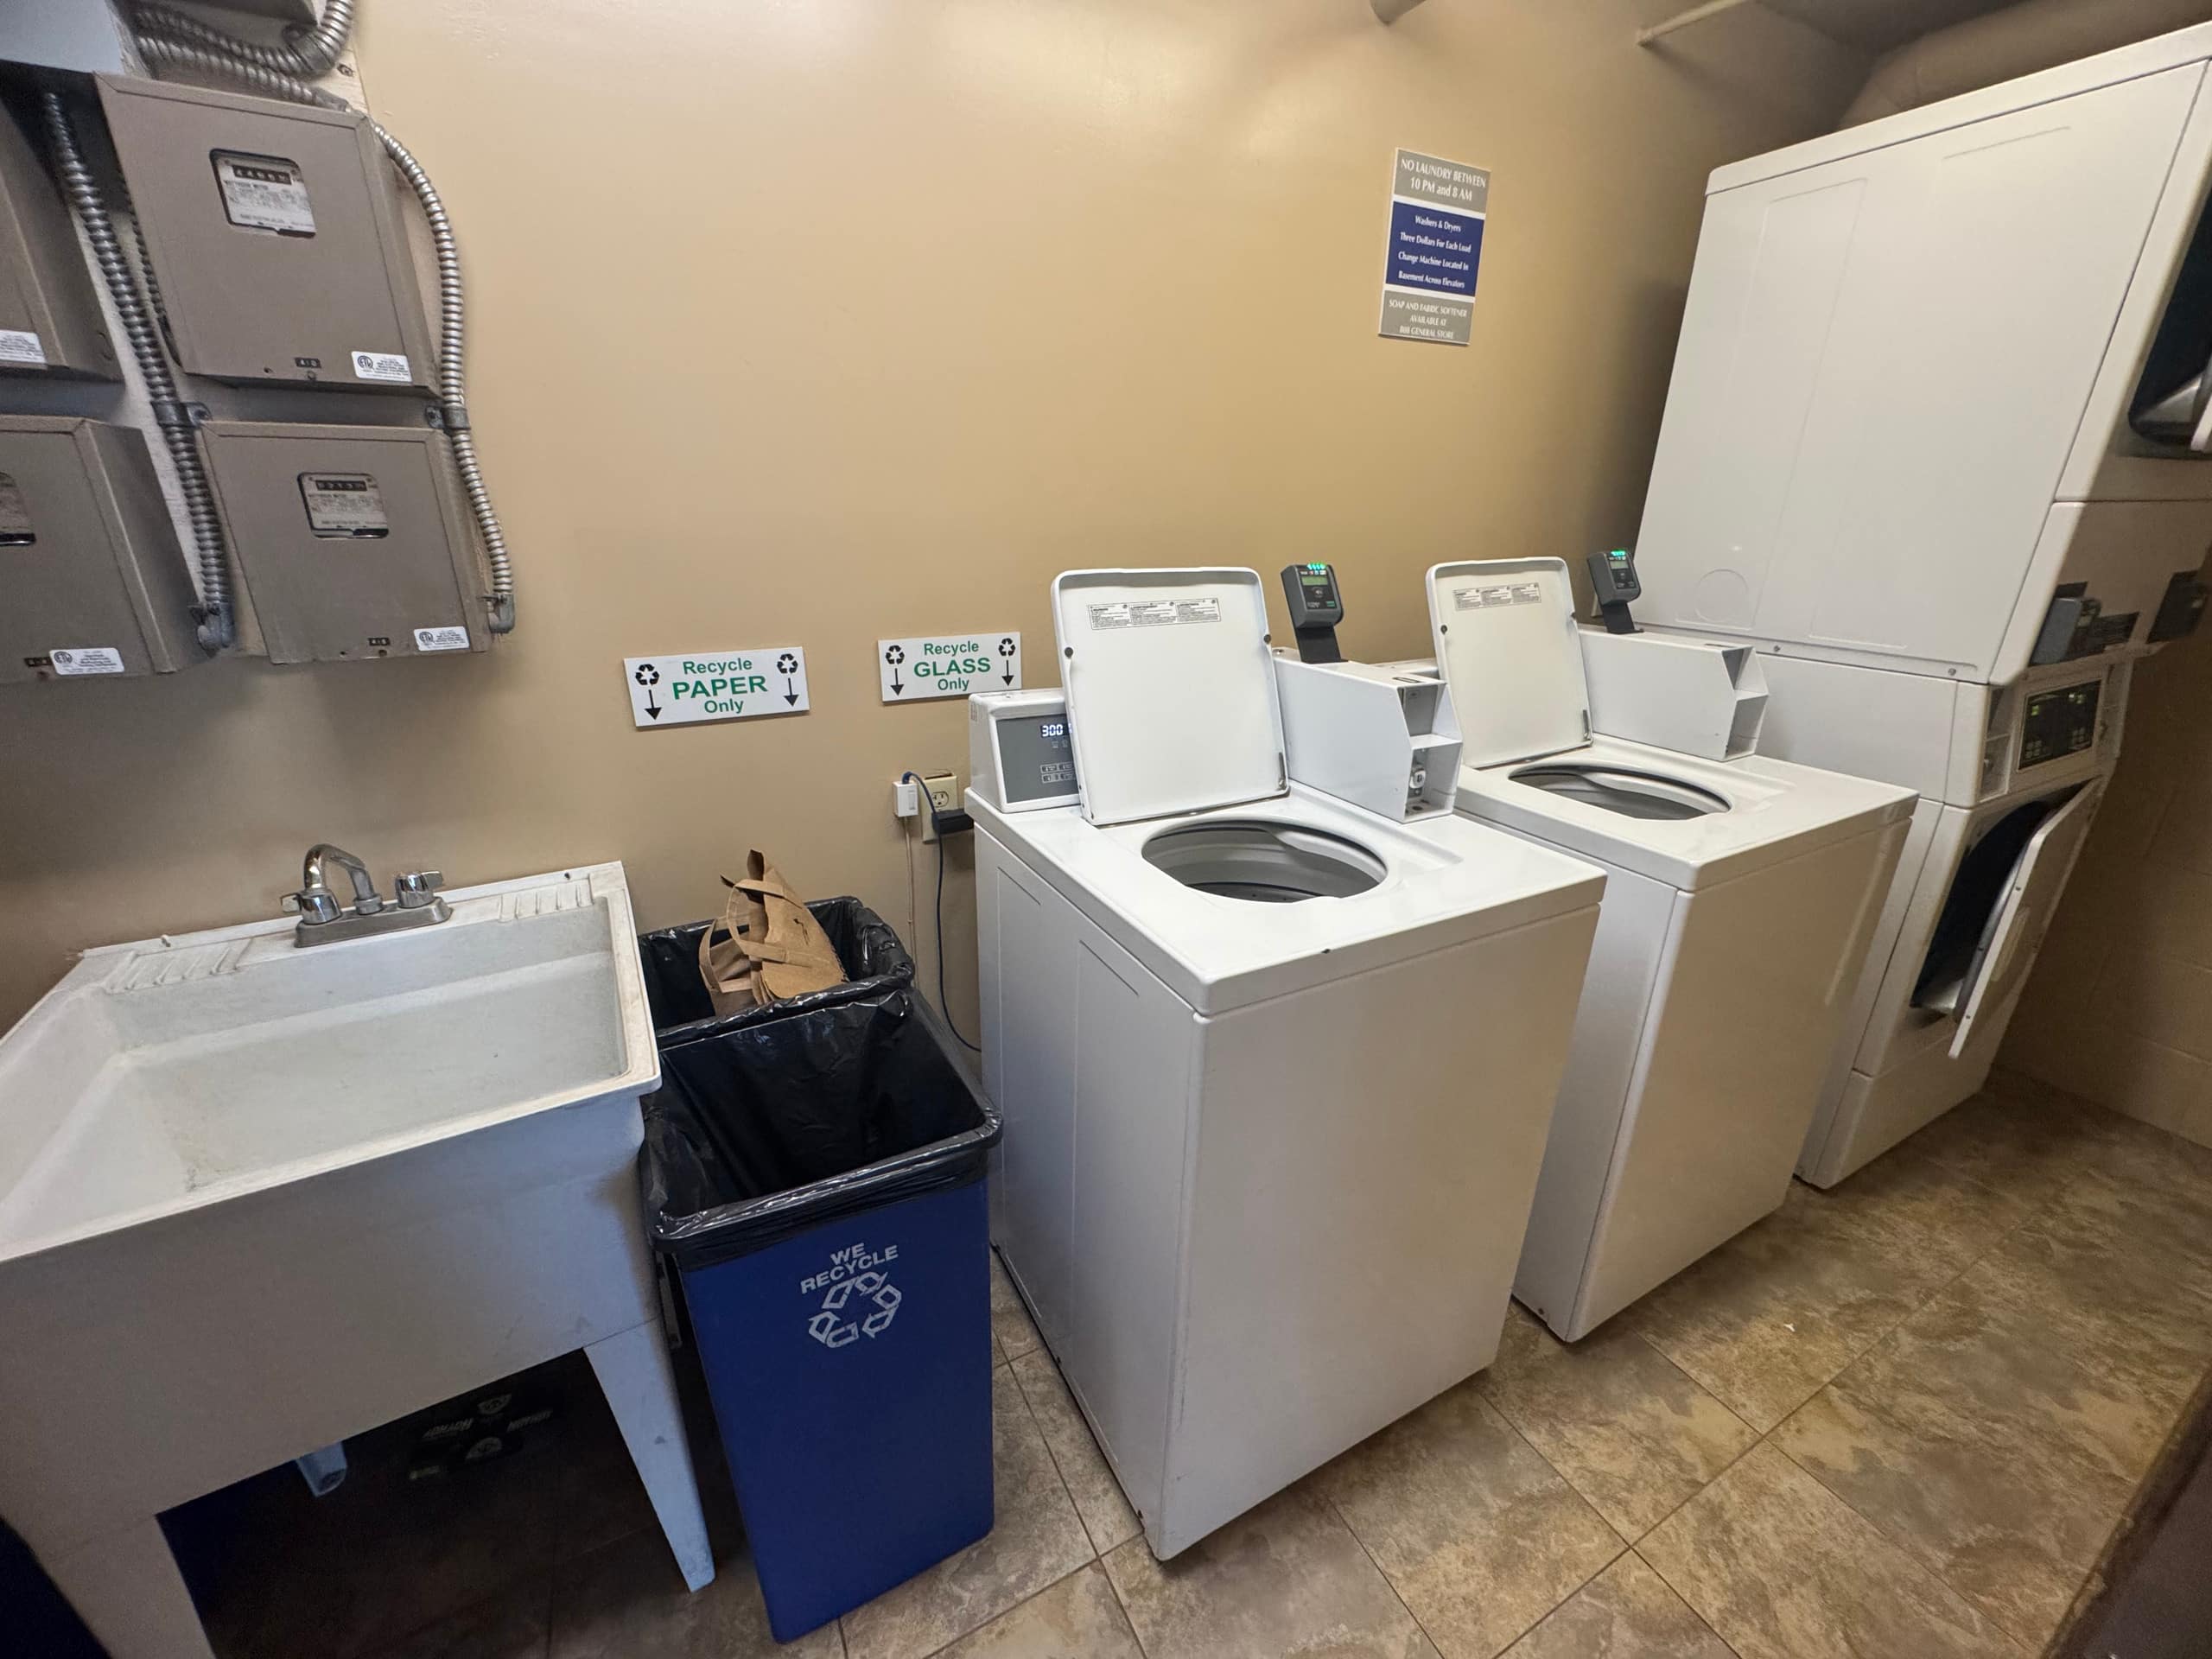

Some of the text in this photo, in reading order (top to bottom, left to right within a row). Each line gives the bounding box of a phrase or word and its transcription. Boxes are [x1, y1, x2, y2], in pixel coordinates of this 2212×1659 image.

[1401, 158, 1486, 188] NO LAUNDRY BETWEEN
[1410, 176, 1472, 201] 10 PM and 8 AM
[1414, 215, 1461, 232] Washers & Dryers
[1400, 232, 1471, 253] Three Dollars For Each Load
[1398, 251, 1418, 264] Change
[1419, 255, 1442, 266] Machine
[1442, 259, 1463, 270] Located
[1398, 270, 1465, 289] Basement Across Elevators
[1389, 299, 1467, 317] SOAP AND FABRIC SOFTENER
[1410, 315, 1440, 326] AVAILABLE
[924, 640, 979, 657] Recycle
[683, 657, 753, 676] Recycle
[913, 657, 991, 677] GLASS
[672, 675, 768, 700] PAPER
[938, 677, 969, 692] Only
[704, 698, 744, 714] Only
[1042, 724, 1064, 737] 300
[830, 1243, 866, 1265] WE
[800, 1244, 899, 1294] RECYCLE
